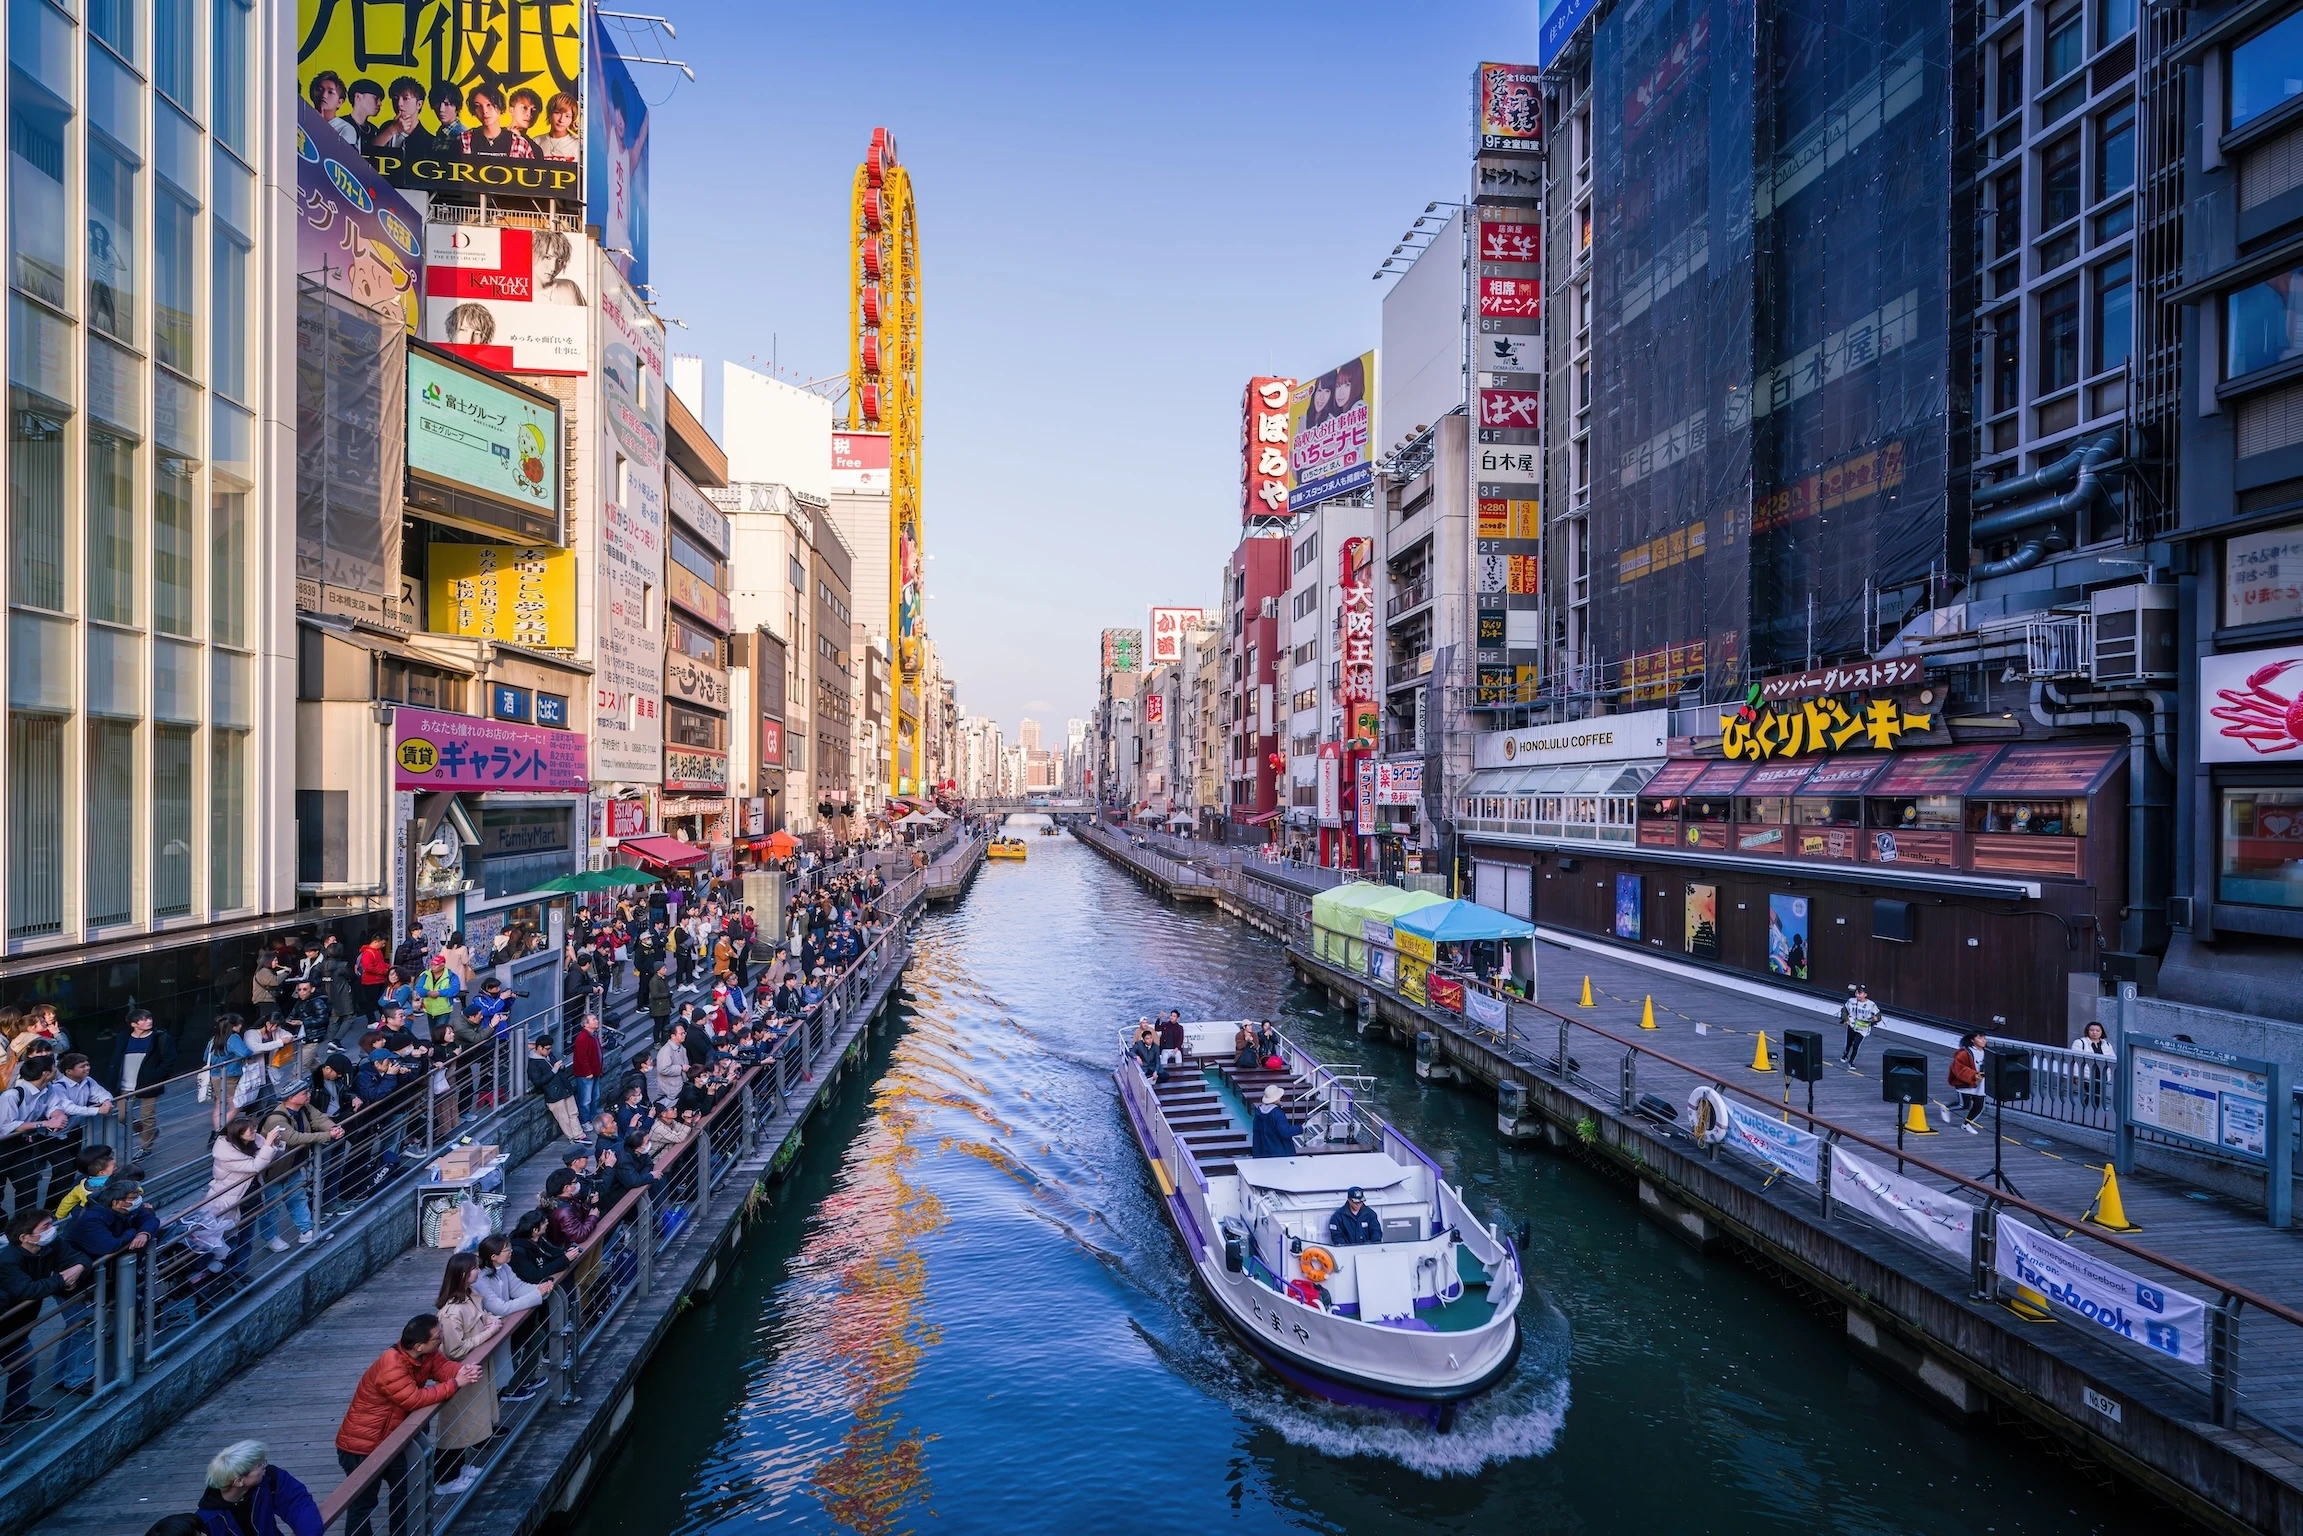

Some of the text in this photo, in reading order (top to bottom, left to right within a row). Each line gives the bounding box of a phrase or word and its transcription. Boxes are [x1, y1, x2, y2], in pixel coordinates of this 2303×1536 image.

[1486, 136, 1540, 150] 9F 全室個室
[334, 165, 365, 209] リフォーム
[411, 160, 577, 190] GROUP
[470, 272, 529, 288] KANZAKI
[492, 285, 528, 297] RUKA
[1490, 281, 1515, 295] 相席
[1481, 296, 1540, 315] ダイニング
[510, 334, 573, 345] めっちゃ面白いを
[1771, 325, 1874, 406] 白木屋
[445, 393, 508, 426] 富士グループ
[1481, 394, 1538, 424] はや
[1293, 405, 1368, 451] 高収入お仕事情報
[832, 438, 851, 455] 税
[1293, 425, 1368, 470] いちごナビ
[836, 458, 862, 468] Free
[1482, 450, 1535, 472] 白木屋
[328, 591, 367, 612] 日本橋支店
[456, 580, 474, 629] 応援します
[480, 549, 498, 635] あなたのお店づくり
[513, 550, 548, 645] 素晴らしい夢の実現
[1910, 604, 1924, 617] 2F
[1481, 628, 1503, 638] ドンキー
[1482, 621, 1502, 629] びっくり
[1346, 581, 1373, 701] 大阪王将
[679, 662, 716, 703] うなぎ
[1763, 661, 1917, 697] ハンバーグレストラン
[503, 691, 559, 721] 酒 たばこ
[599, 690, 626, 713] コスパ
[421, 718, 546, 744] あなたも憧れのお店のオーナーに!
[766, 729, 778, 754] G3
[1520, 732, 1614, 752] HONOLULU COFFEE
[1720, 696, 1932, 761] びっくりドンキー
[402, 740, 548, 780] 賃貸 の ギャラント
[1391, 792, 1407, 803] 免税
[500, 825, 557, 848] FamilyMart
[1732, 1106, 1785, 1140] twitter
[2013, 1245, 2060, 1277] Find me on:
[2032, 1241, 2128, 1294] kamenjoshi facebook
[2015, 1255, 2133, 1338] facebook
[2089, 1391, 2116, 1416] No.97
